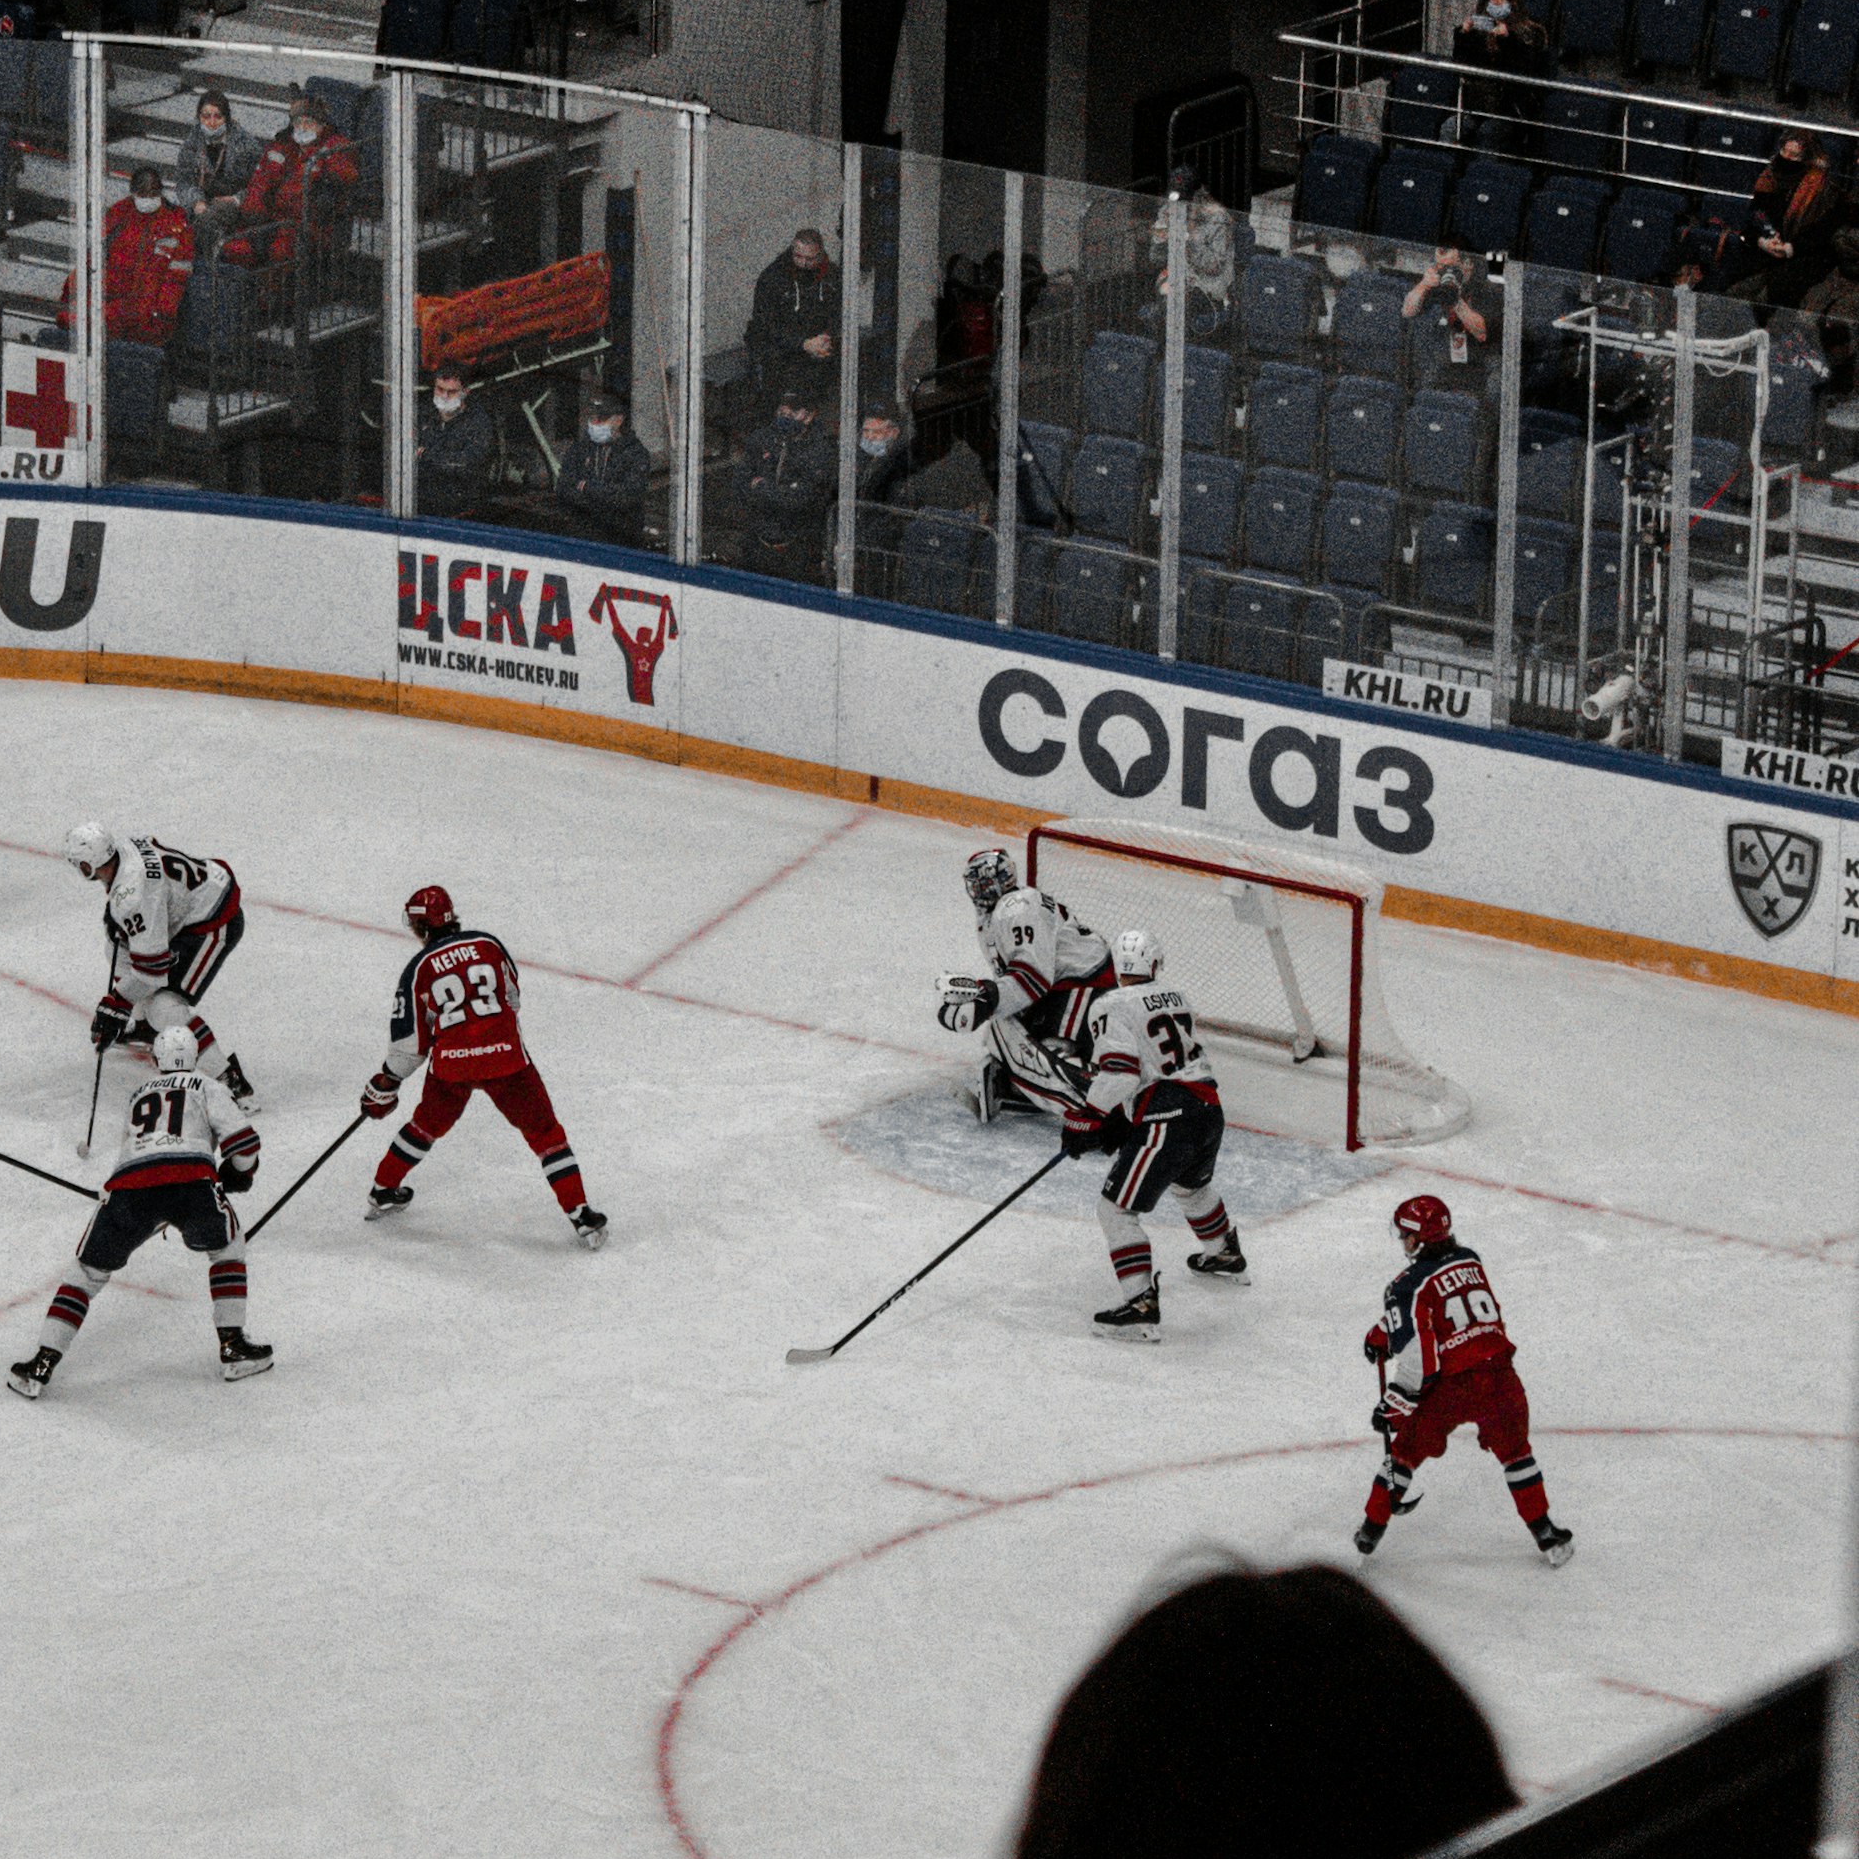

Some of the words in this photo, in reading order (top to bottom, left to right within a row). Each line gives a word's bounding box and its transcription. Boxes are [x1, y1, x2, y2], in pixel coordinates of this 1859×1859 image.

[398, 550, 577, 656] ЦСКА
[397, 642, 580, 691] WWW.CSKA-HOCKEY.RU
[1342, 666, 1472, 719] KHL.RU
[123, 912, 146, 937] 22
[1011, 924, 1035, 946] 39
[430, 944, 481, 974] KEMPE
[431, 962, 503, 1031] 23
[1141, 990, 1183, 1014] OSIPOV
[1091, 1012, 1109, 1040] 37
[131, 1089, 187, 1140] 91
